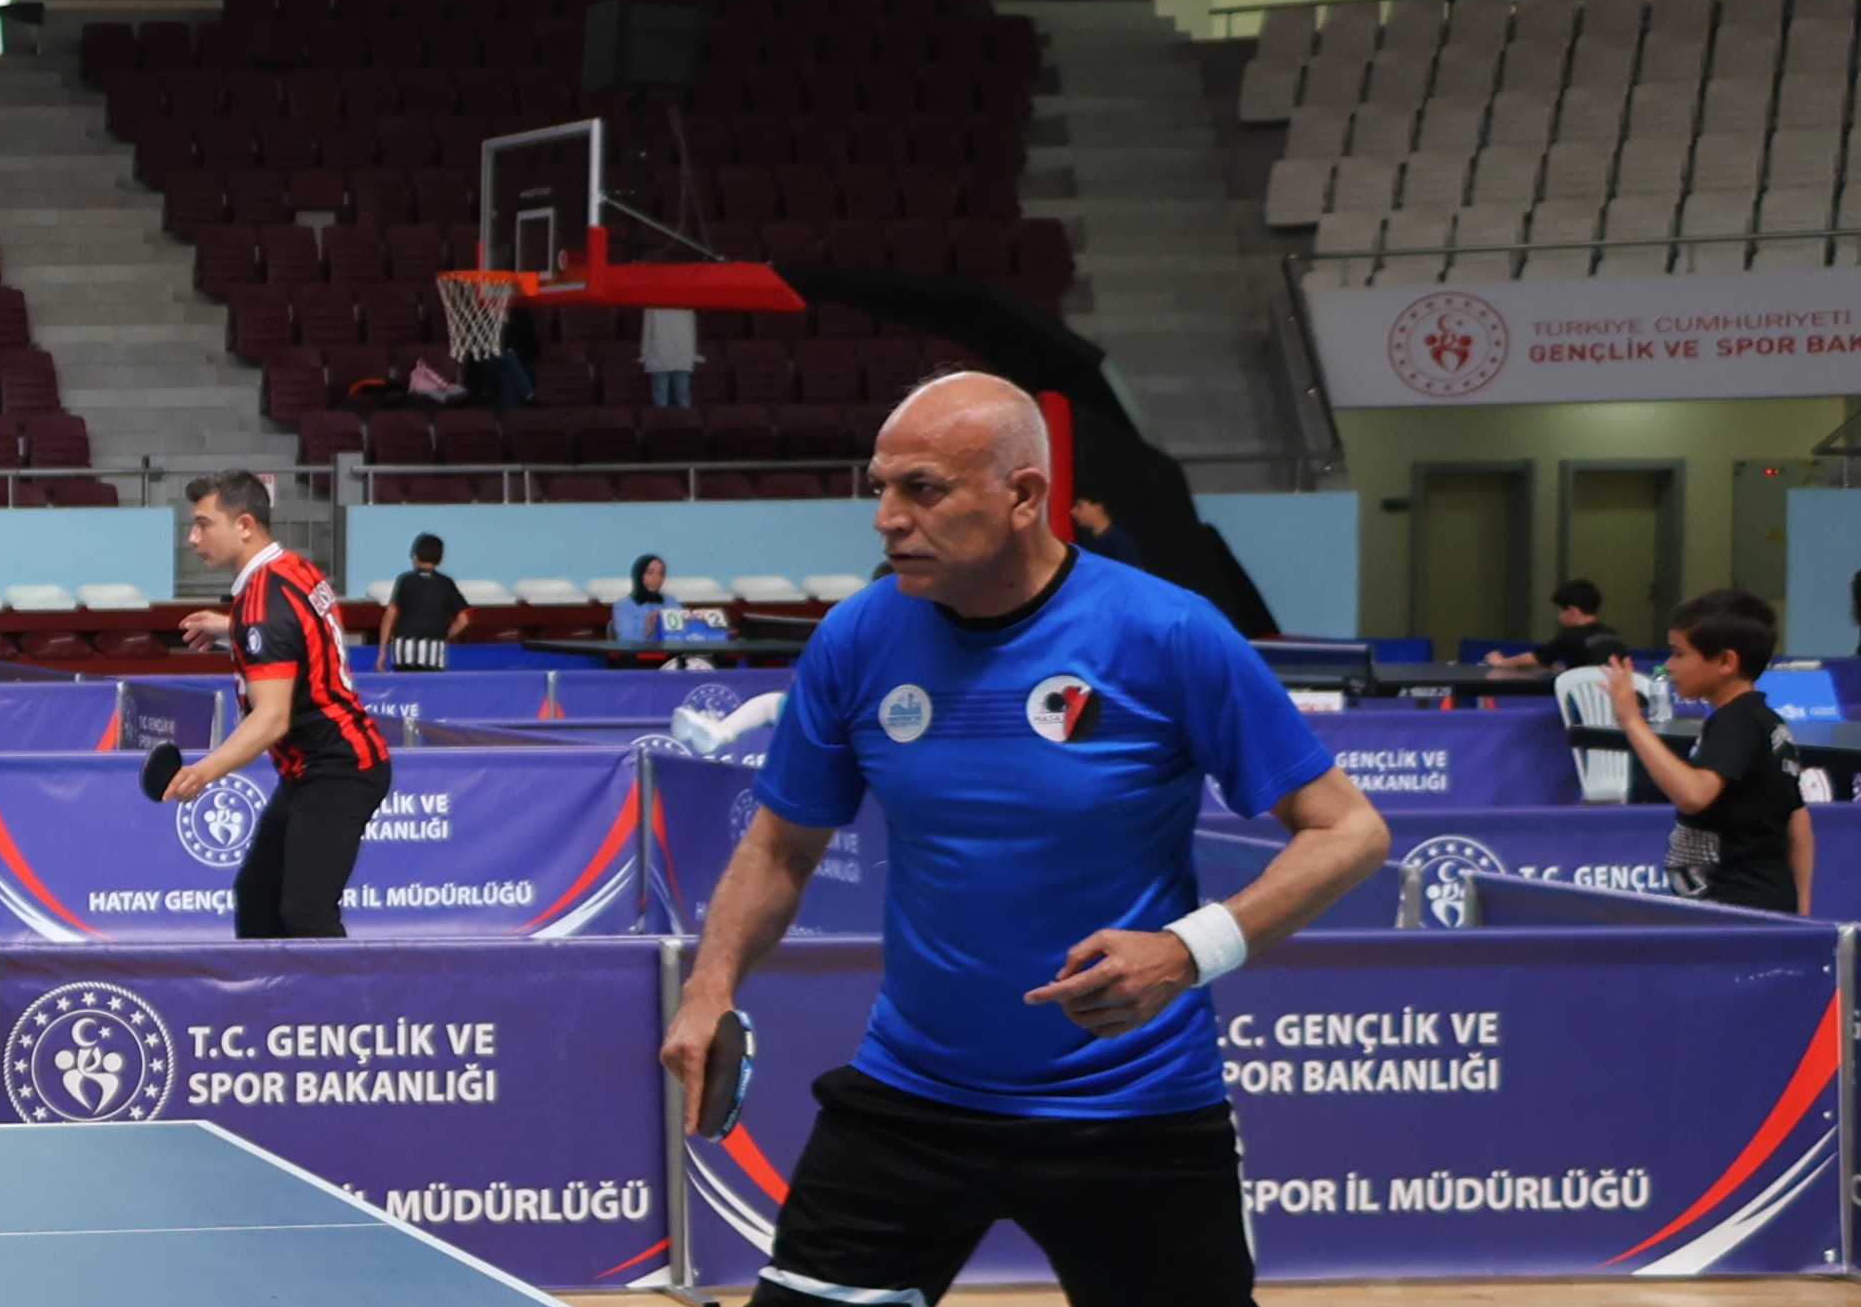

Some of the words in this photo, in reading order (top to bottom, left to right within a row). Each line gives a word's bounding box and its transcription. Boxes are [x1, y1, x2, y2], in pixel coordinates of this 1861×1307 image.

[1532, 314, 1644, 338] TÜRKİYE
[1653, 308, 1852, 334] CUMHURİYETİ
[1529, 339, 1654, 366] GENÇLİK
[1664, 338, 1700, 358] VE
[1716, 335, 1796, 358] SPOR
[1422, 749, 1447, 769] VE
[420, 793, 448, 815] VE
[89, 891, 161, 913] HATAY
[361, 884, 382, 909] İL
[386, 880, 533, 907] MÜDÜRLÜĞÜ
[188, 1026, 255, 1059] T.C.
[267, 1016, 435, 1065] GENÇLİK
[448, 1022, 495, 1056] VE
[1274, 1005, 1438, 1054] GENÇLİK
[1451, 1012, 1498, 1045] VE
[188, 1071, 284, 1105] SPOR
[295, 1063, 496, 1104] BAKANLIĞI
[1302, 1050, 1499, 1092] BAKANLIĞI
[385, 1180, 651, 1222] MÜDÜRLÜĞÜ
[1345, 1172, 1379, 1211] İL
[1389, 1167, 1650, 1212] MÜDÜRLÜĞÜ
